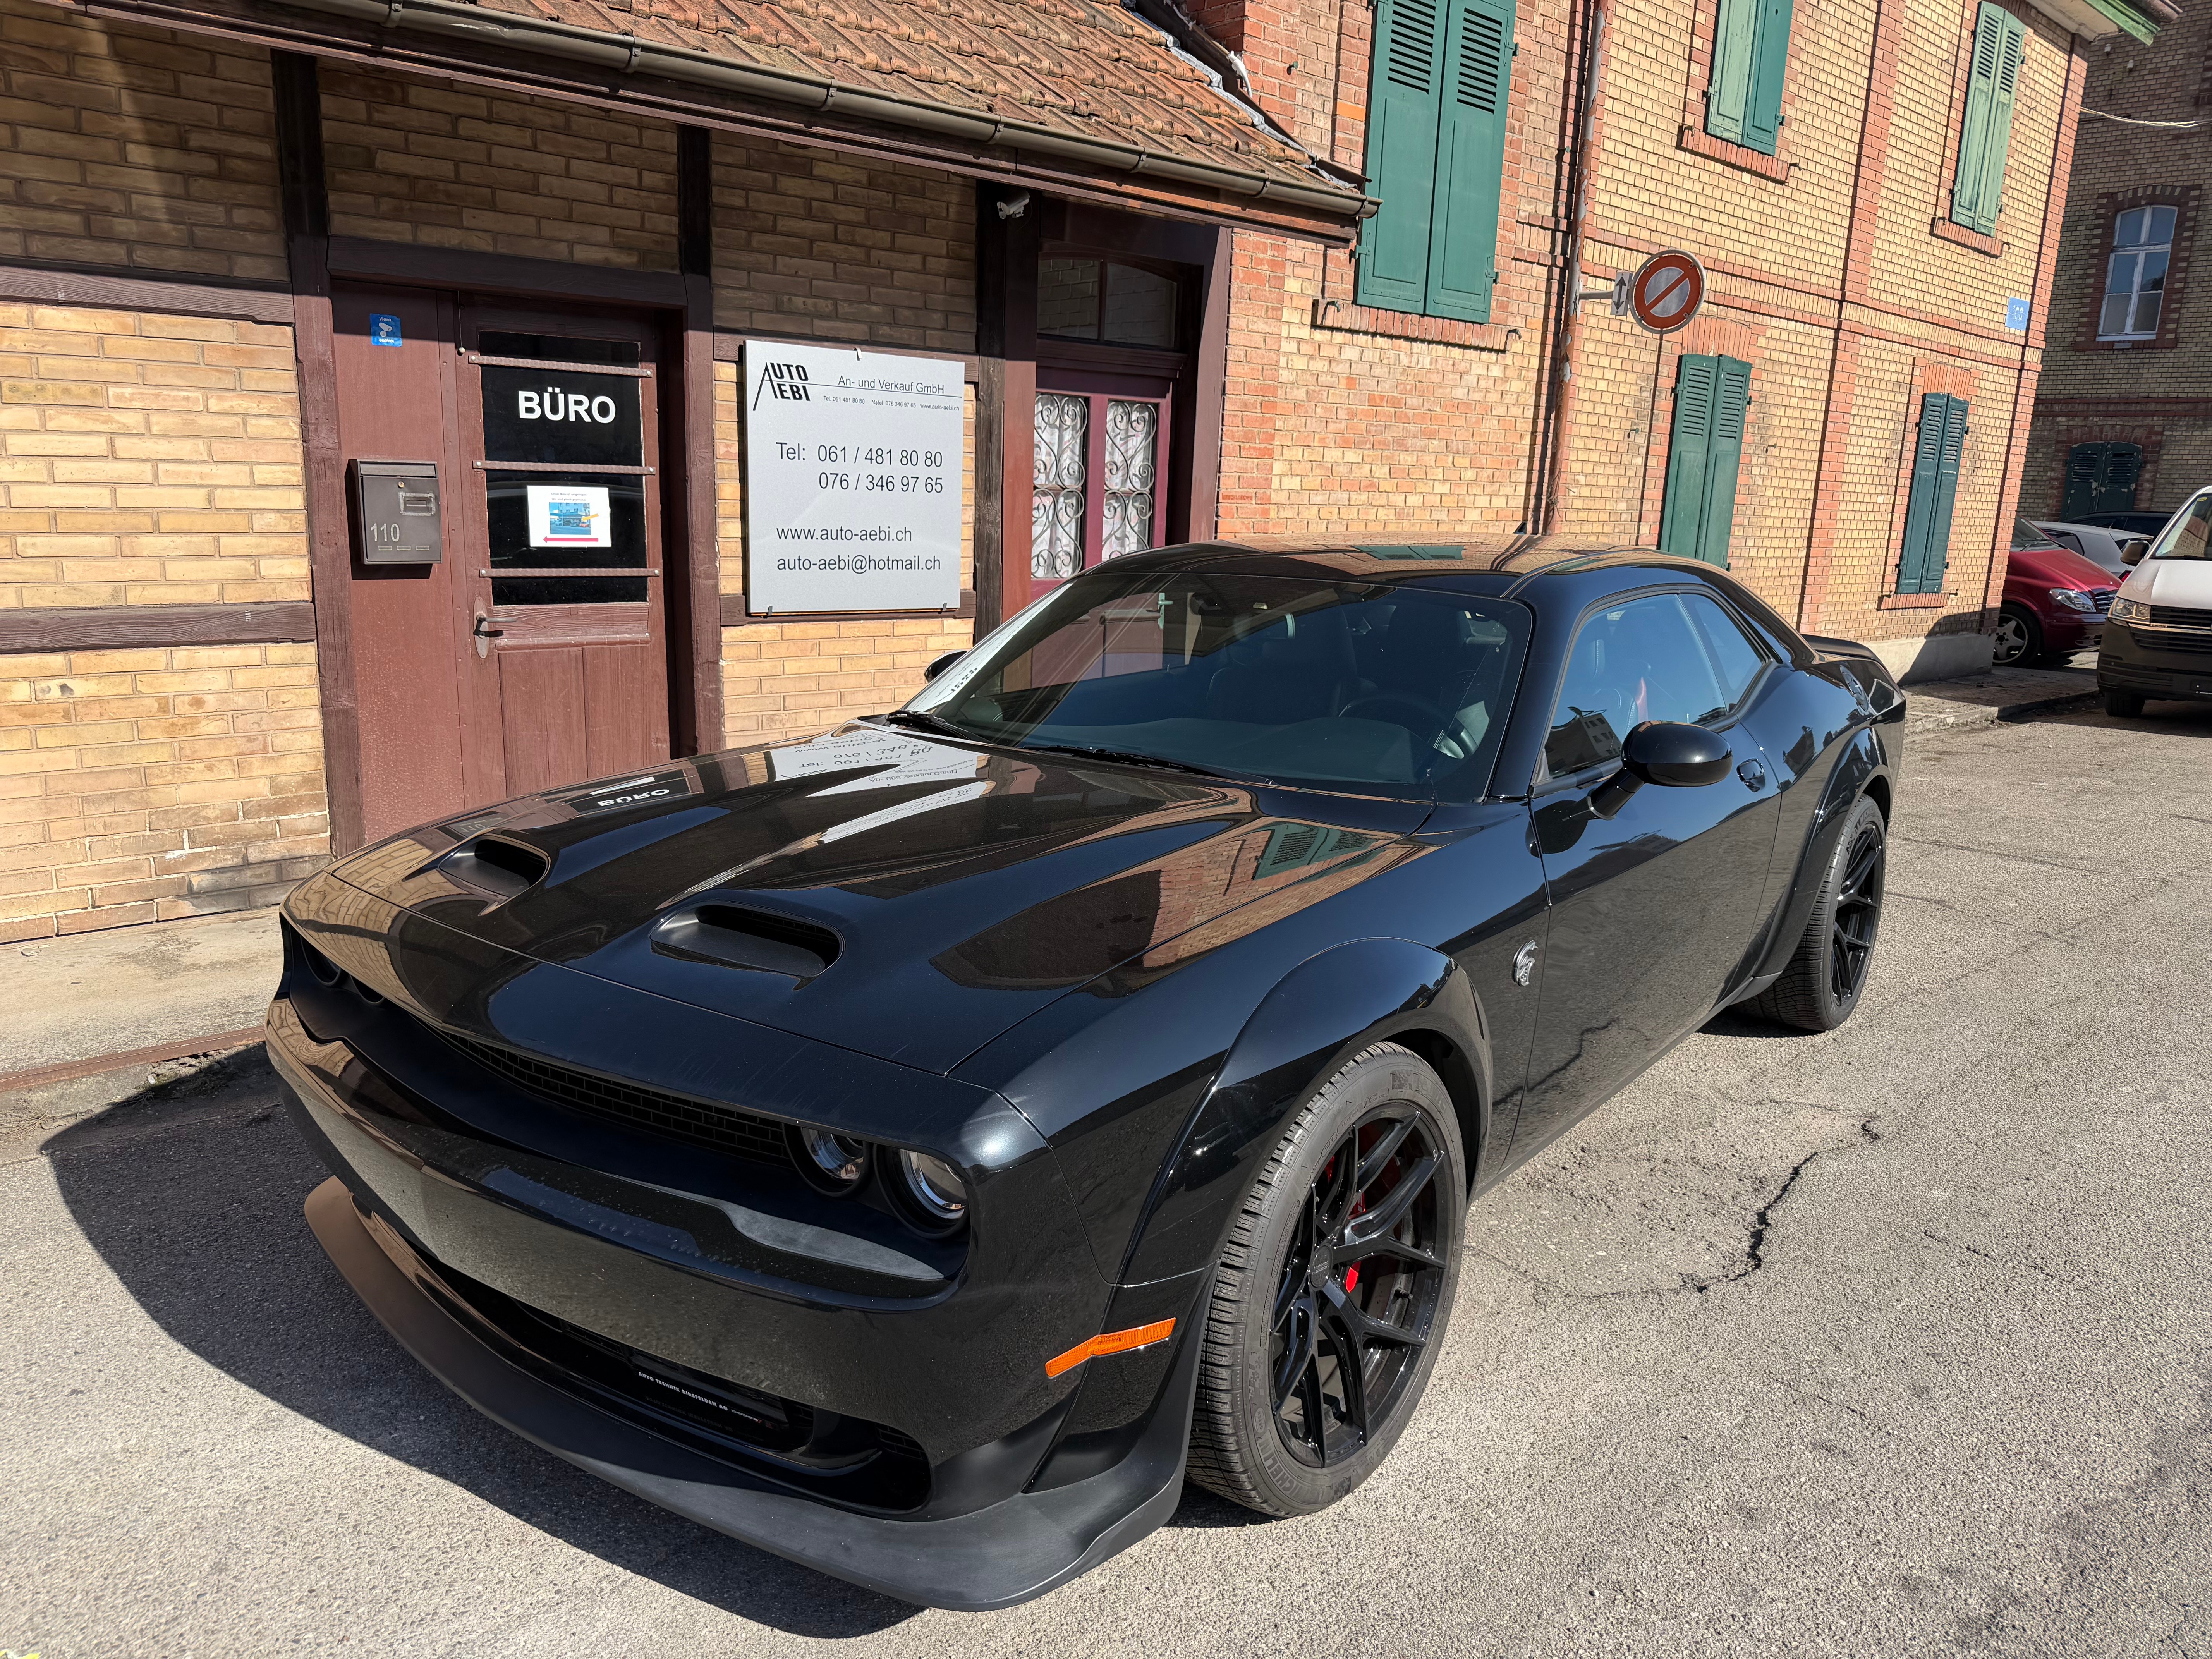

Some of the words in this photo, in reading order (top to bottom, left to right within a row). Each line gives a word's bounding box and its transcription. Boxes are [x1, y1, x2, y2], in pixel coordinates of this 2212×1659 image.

[838, 376, 855, 386] An-
[858, 378, 875, 388] und
[878, 379, 914, 391] Verkauf
[916, 383, 945, 394] GmbH
[518, 387, 616, 424] BÜRO
[776, 442, 805, 460] Tel:
[818, 445, 847, 463] 061
[854, 447, 859, 464] /
[865, 447, 892, 465] 481
[900, 449, 919, 467] 80
[924, 451, 942, 468] 80
[819, 472, 849, 490] 076
[855, 473, 860, 491] /
[866, 474, 895, 492] 346
[901, 476, 919, 493] 97
[925, 477, 943, 493] 65
[371, 523, 400, 542] 110
[776, 526, 912, 542] www.auto-aebi.ch
[777, 555, 941, 574] auto-aebi@hotmail.ch
[639, 1371, 654, 1382] AUTO
[655, 1379, 681, 1393] TECHNIK
[682, 1389, 717, 1407] BIRSFELDEN
[1258, 1437, 1309, 1499] MICHELIN
